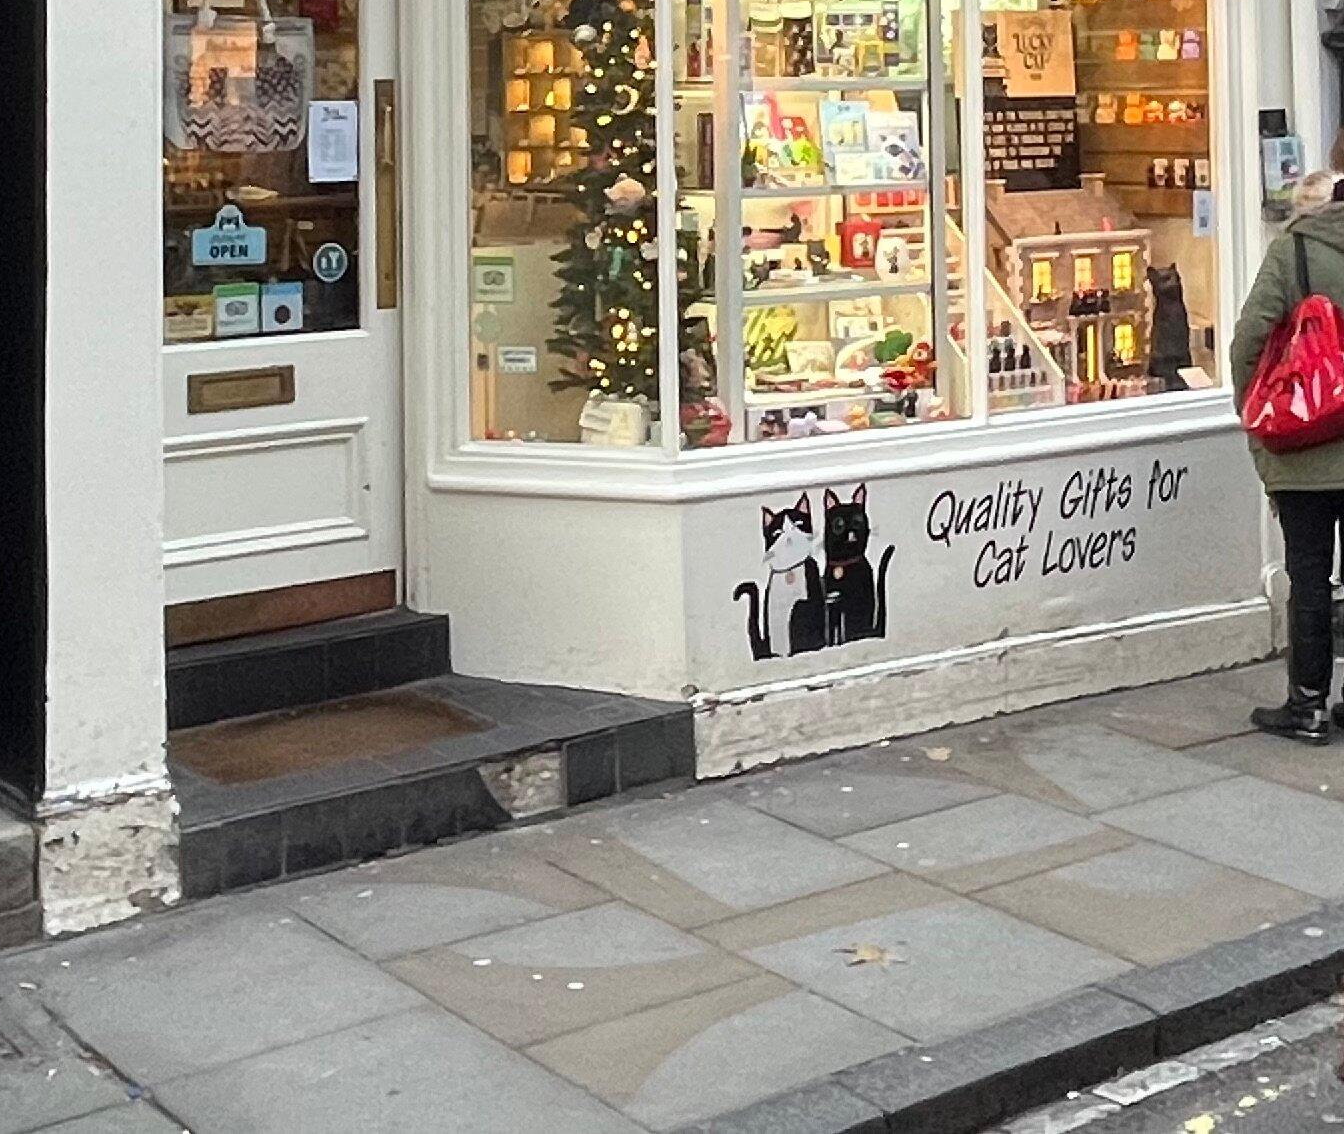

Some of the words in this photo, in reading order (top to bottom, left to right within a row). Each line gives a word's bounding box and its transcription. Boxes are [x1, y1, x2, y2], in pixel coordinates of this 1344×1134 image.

[209, 244, 248, 258] OPEN
[926, 481, 1044, 547] Quality
[1060, 467, 1133, 521] Gifts
[1146, 459, 1188, 510] for
[974, 539, 1030, 589] Cat
[1042, 526, 1136, 576] Lovers
